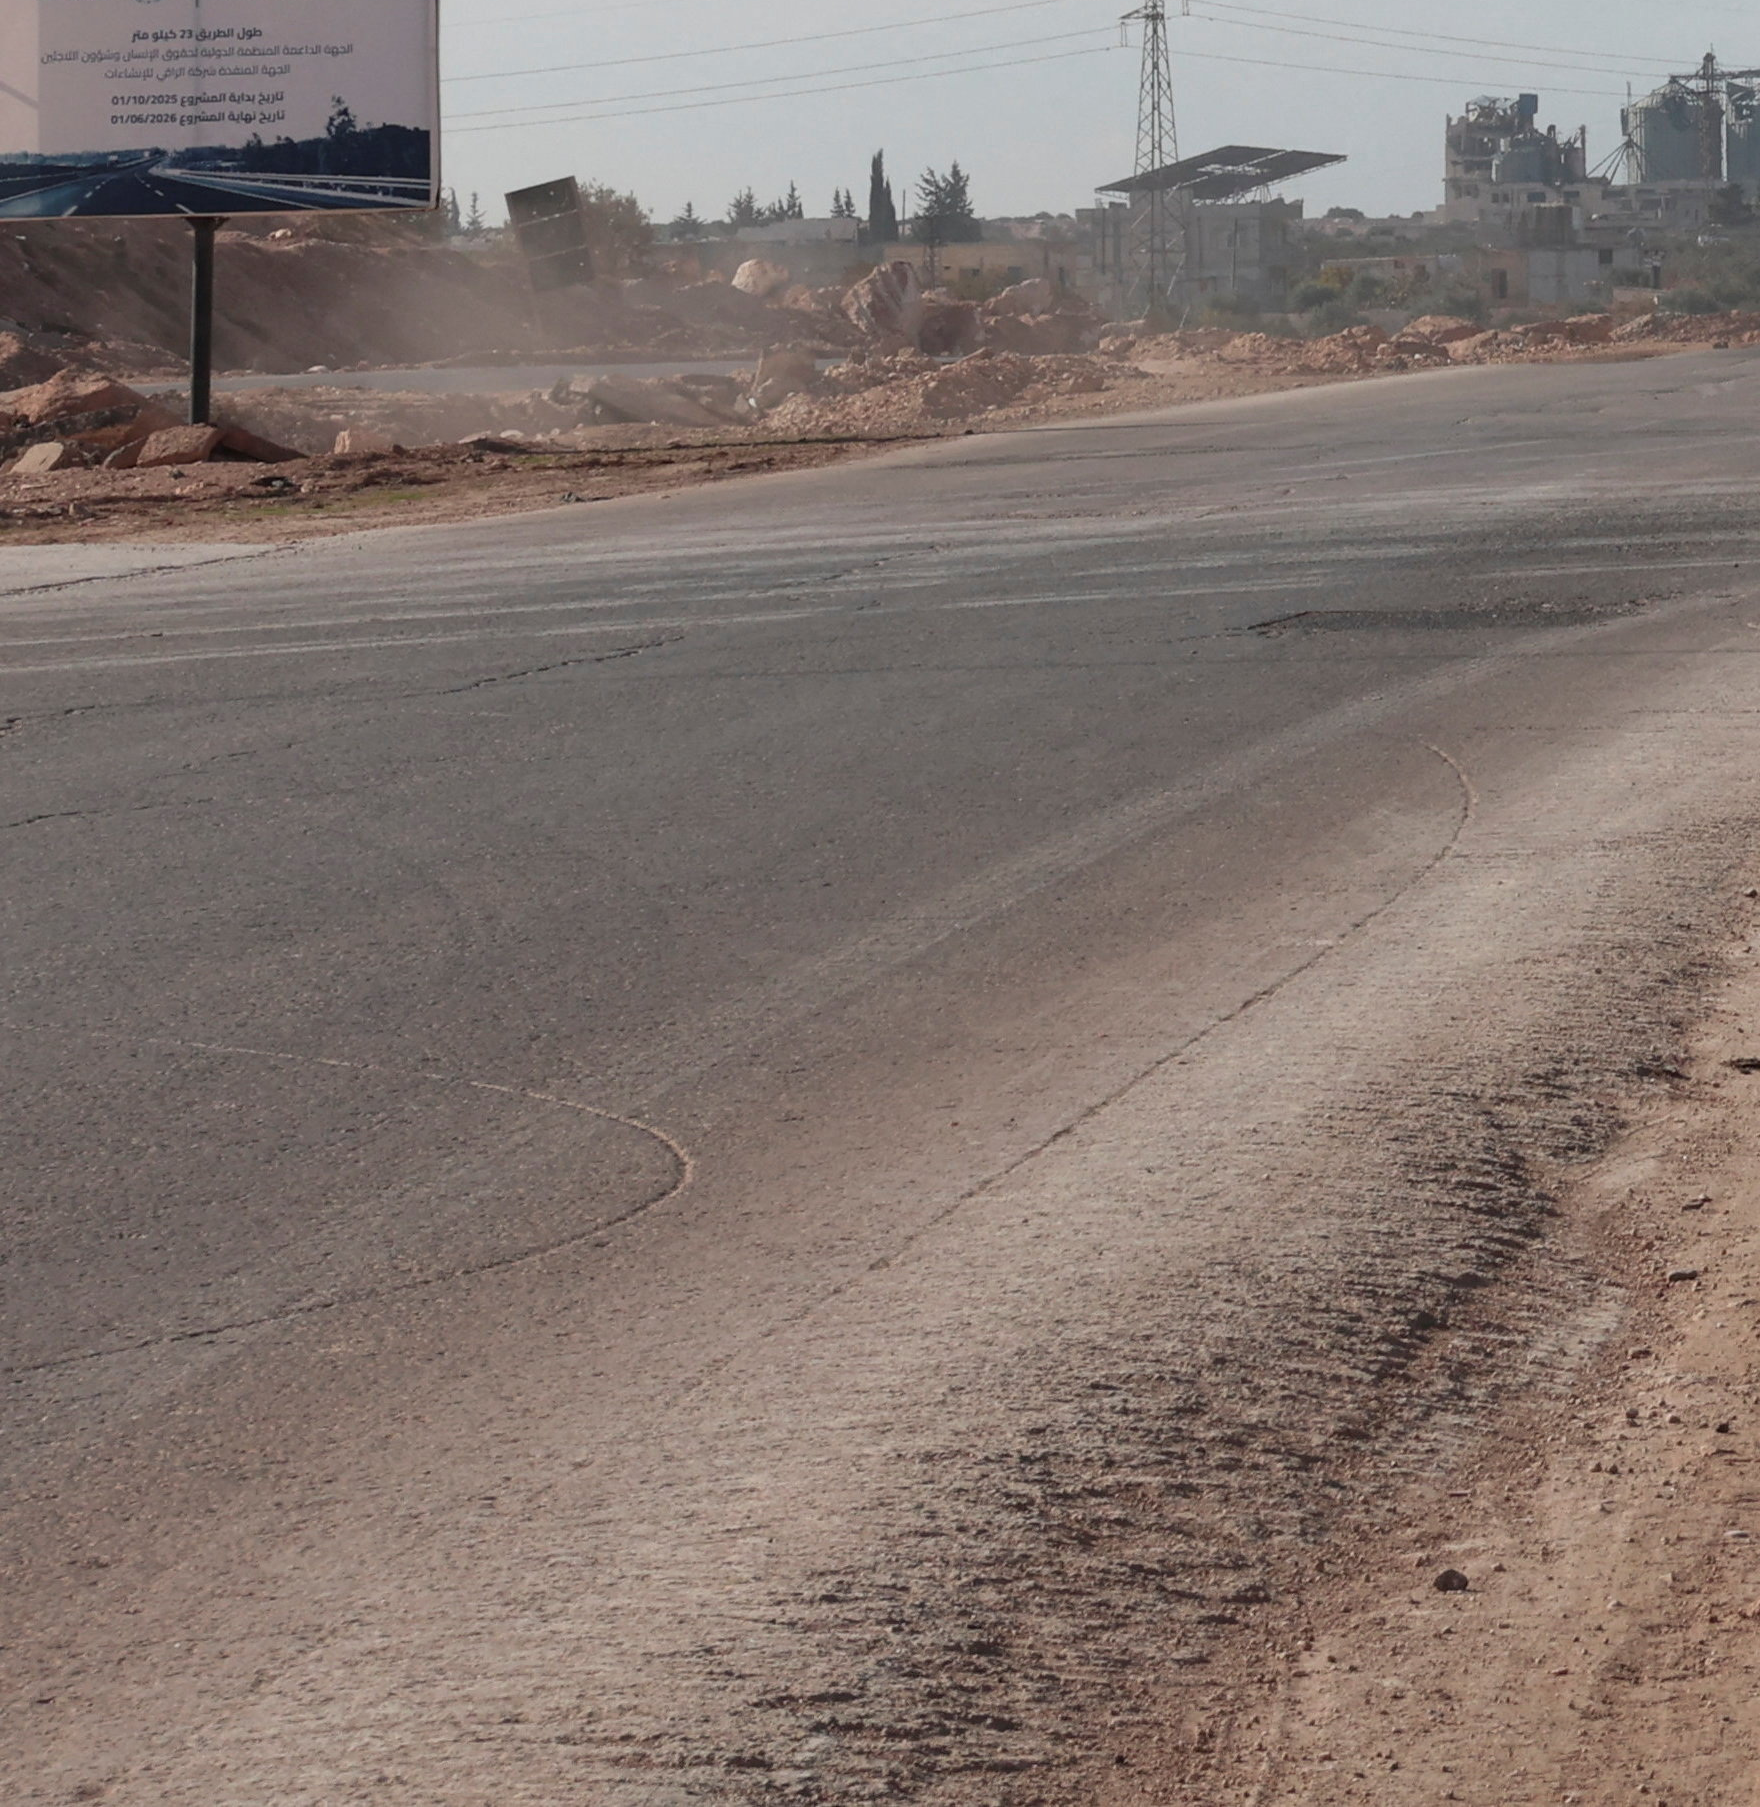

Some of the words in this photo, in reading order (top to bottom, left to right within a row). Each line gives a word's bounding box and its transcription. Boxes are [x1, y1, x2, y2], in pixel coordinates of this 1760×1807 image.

[131, 30, 149, 43] متر
[151, 30, 177, 42] كيلو
[179, 29, 193, 39] 23
[195, 28, 234, 42] الطريق
[237, 27, 262, 40] طول
[323, 43, 353, 57] الجهة
[261, 64, 290, 77] الجهة
[111, 94, 178, 105] 01/10/2025
[180, 92, 226, 107] المشروع
[229, 92, 255, 104] بداية
[258, 91, 284, 105] تاريخ
[110, 113, 177, 124] 01/06/2026
[179, 111, 225, 126] المشروع
[228, 110, 256, 124] نهاية
[258, 109, 285, 124] تاريخ
